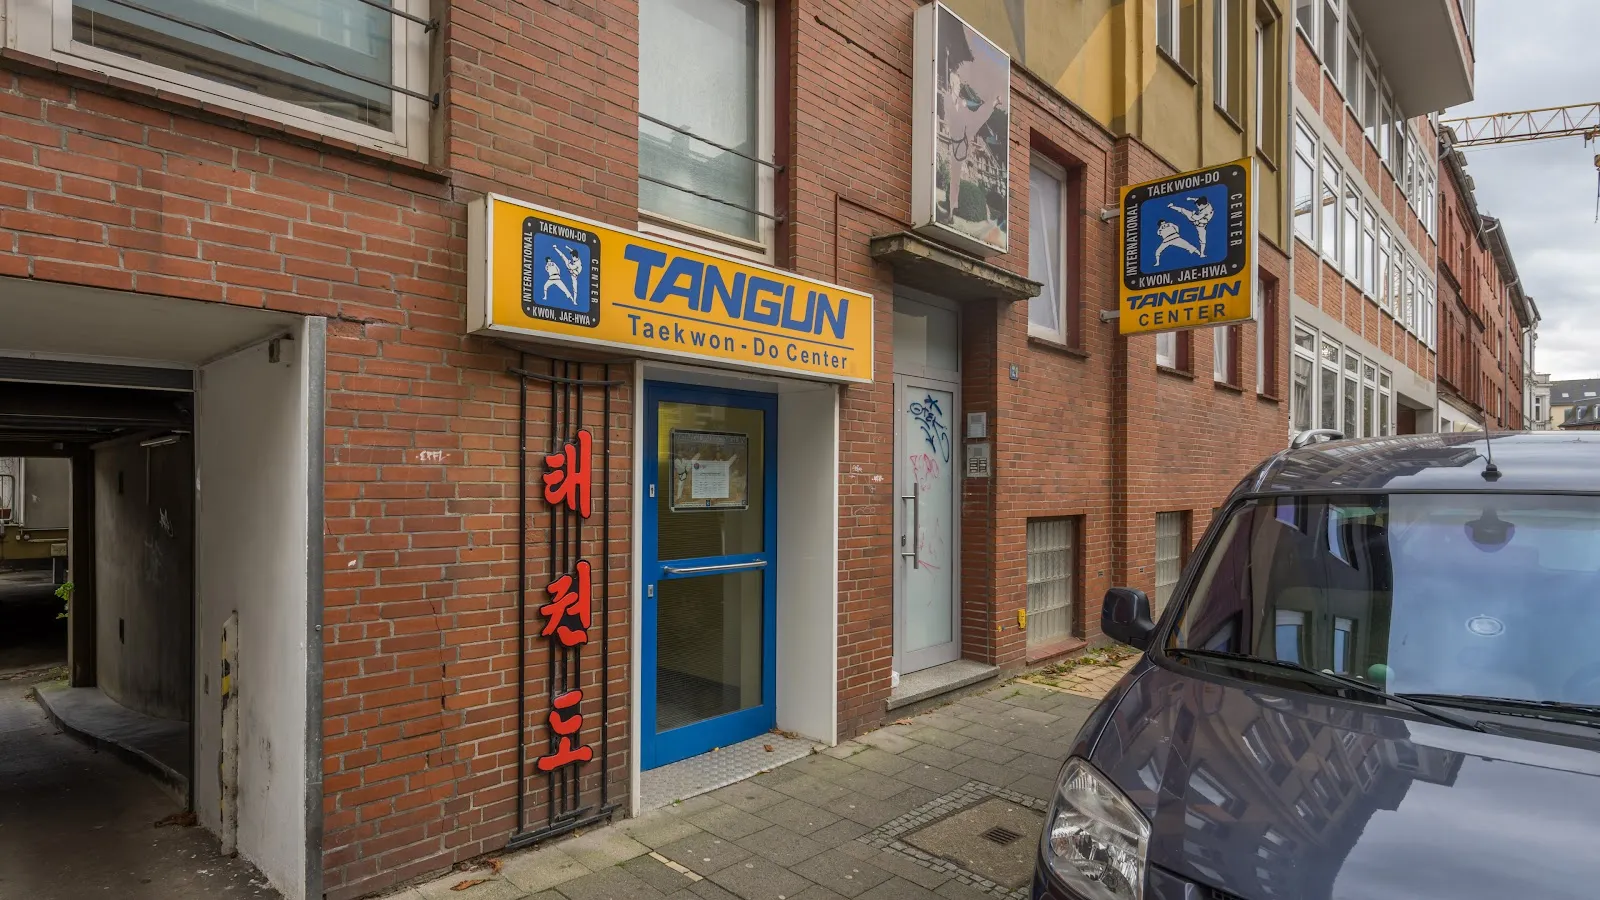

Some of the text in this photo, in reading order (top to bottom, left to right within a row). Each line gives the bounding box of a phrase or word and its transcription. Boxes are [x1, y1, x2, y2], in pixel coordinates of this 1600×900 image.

[1147, 171, 1220, 197] TAEKWON-DO
[540, 221, 587, 242] TAEKWON-DO
[1230, 193, 1242, 247] CENTER
[1126, 203, 1138, 277] INTERNATIONAL
[523, 231, 533, 302] INTERNATIONAL
[591, 258, 599, 303] CENTER
[1139, 263, 1228, 288] KWON, JAE-HWA
[624, 244, 850, 340] TANGUN
[1126, 280, 1241, 311] TANGUN
[532, 305, 591, 326] KWON, JAE-HWA
[1138, 303, 1226, 327] CENTER
[786, 343, 848, 370] Center
